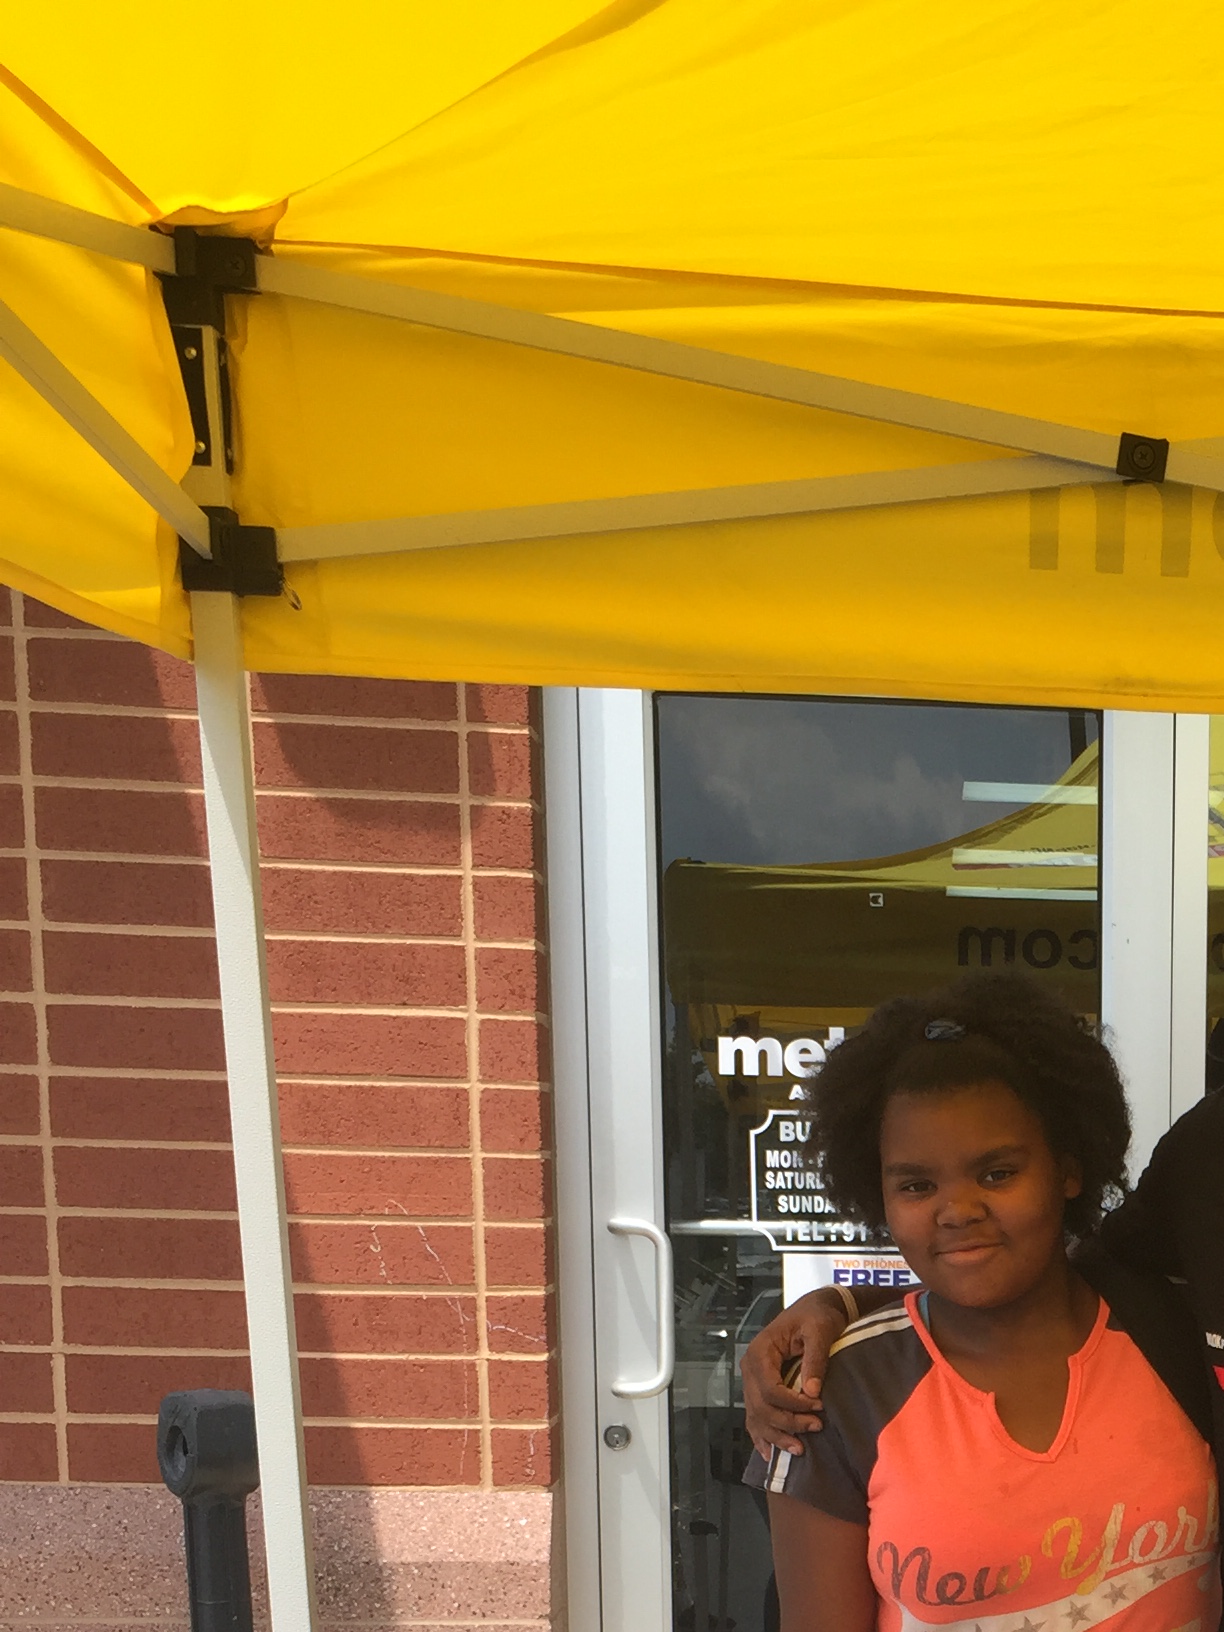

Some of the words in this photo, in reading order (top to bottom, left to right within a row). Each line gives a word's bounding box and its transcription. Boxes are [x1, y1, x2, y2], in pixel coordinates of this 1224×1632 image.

[833, 1259, 861, 1269] TWO
[833, 1269, 911, 1287] FREE
[876, 1541, 1032, 1607] New
